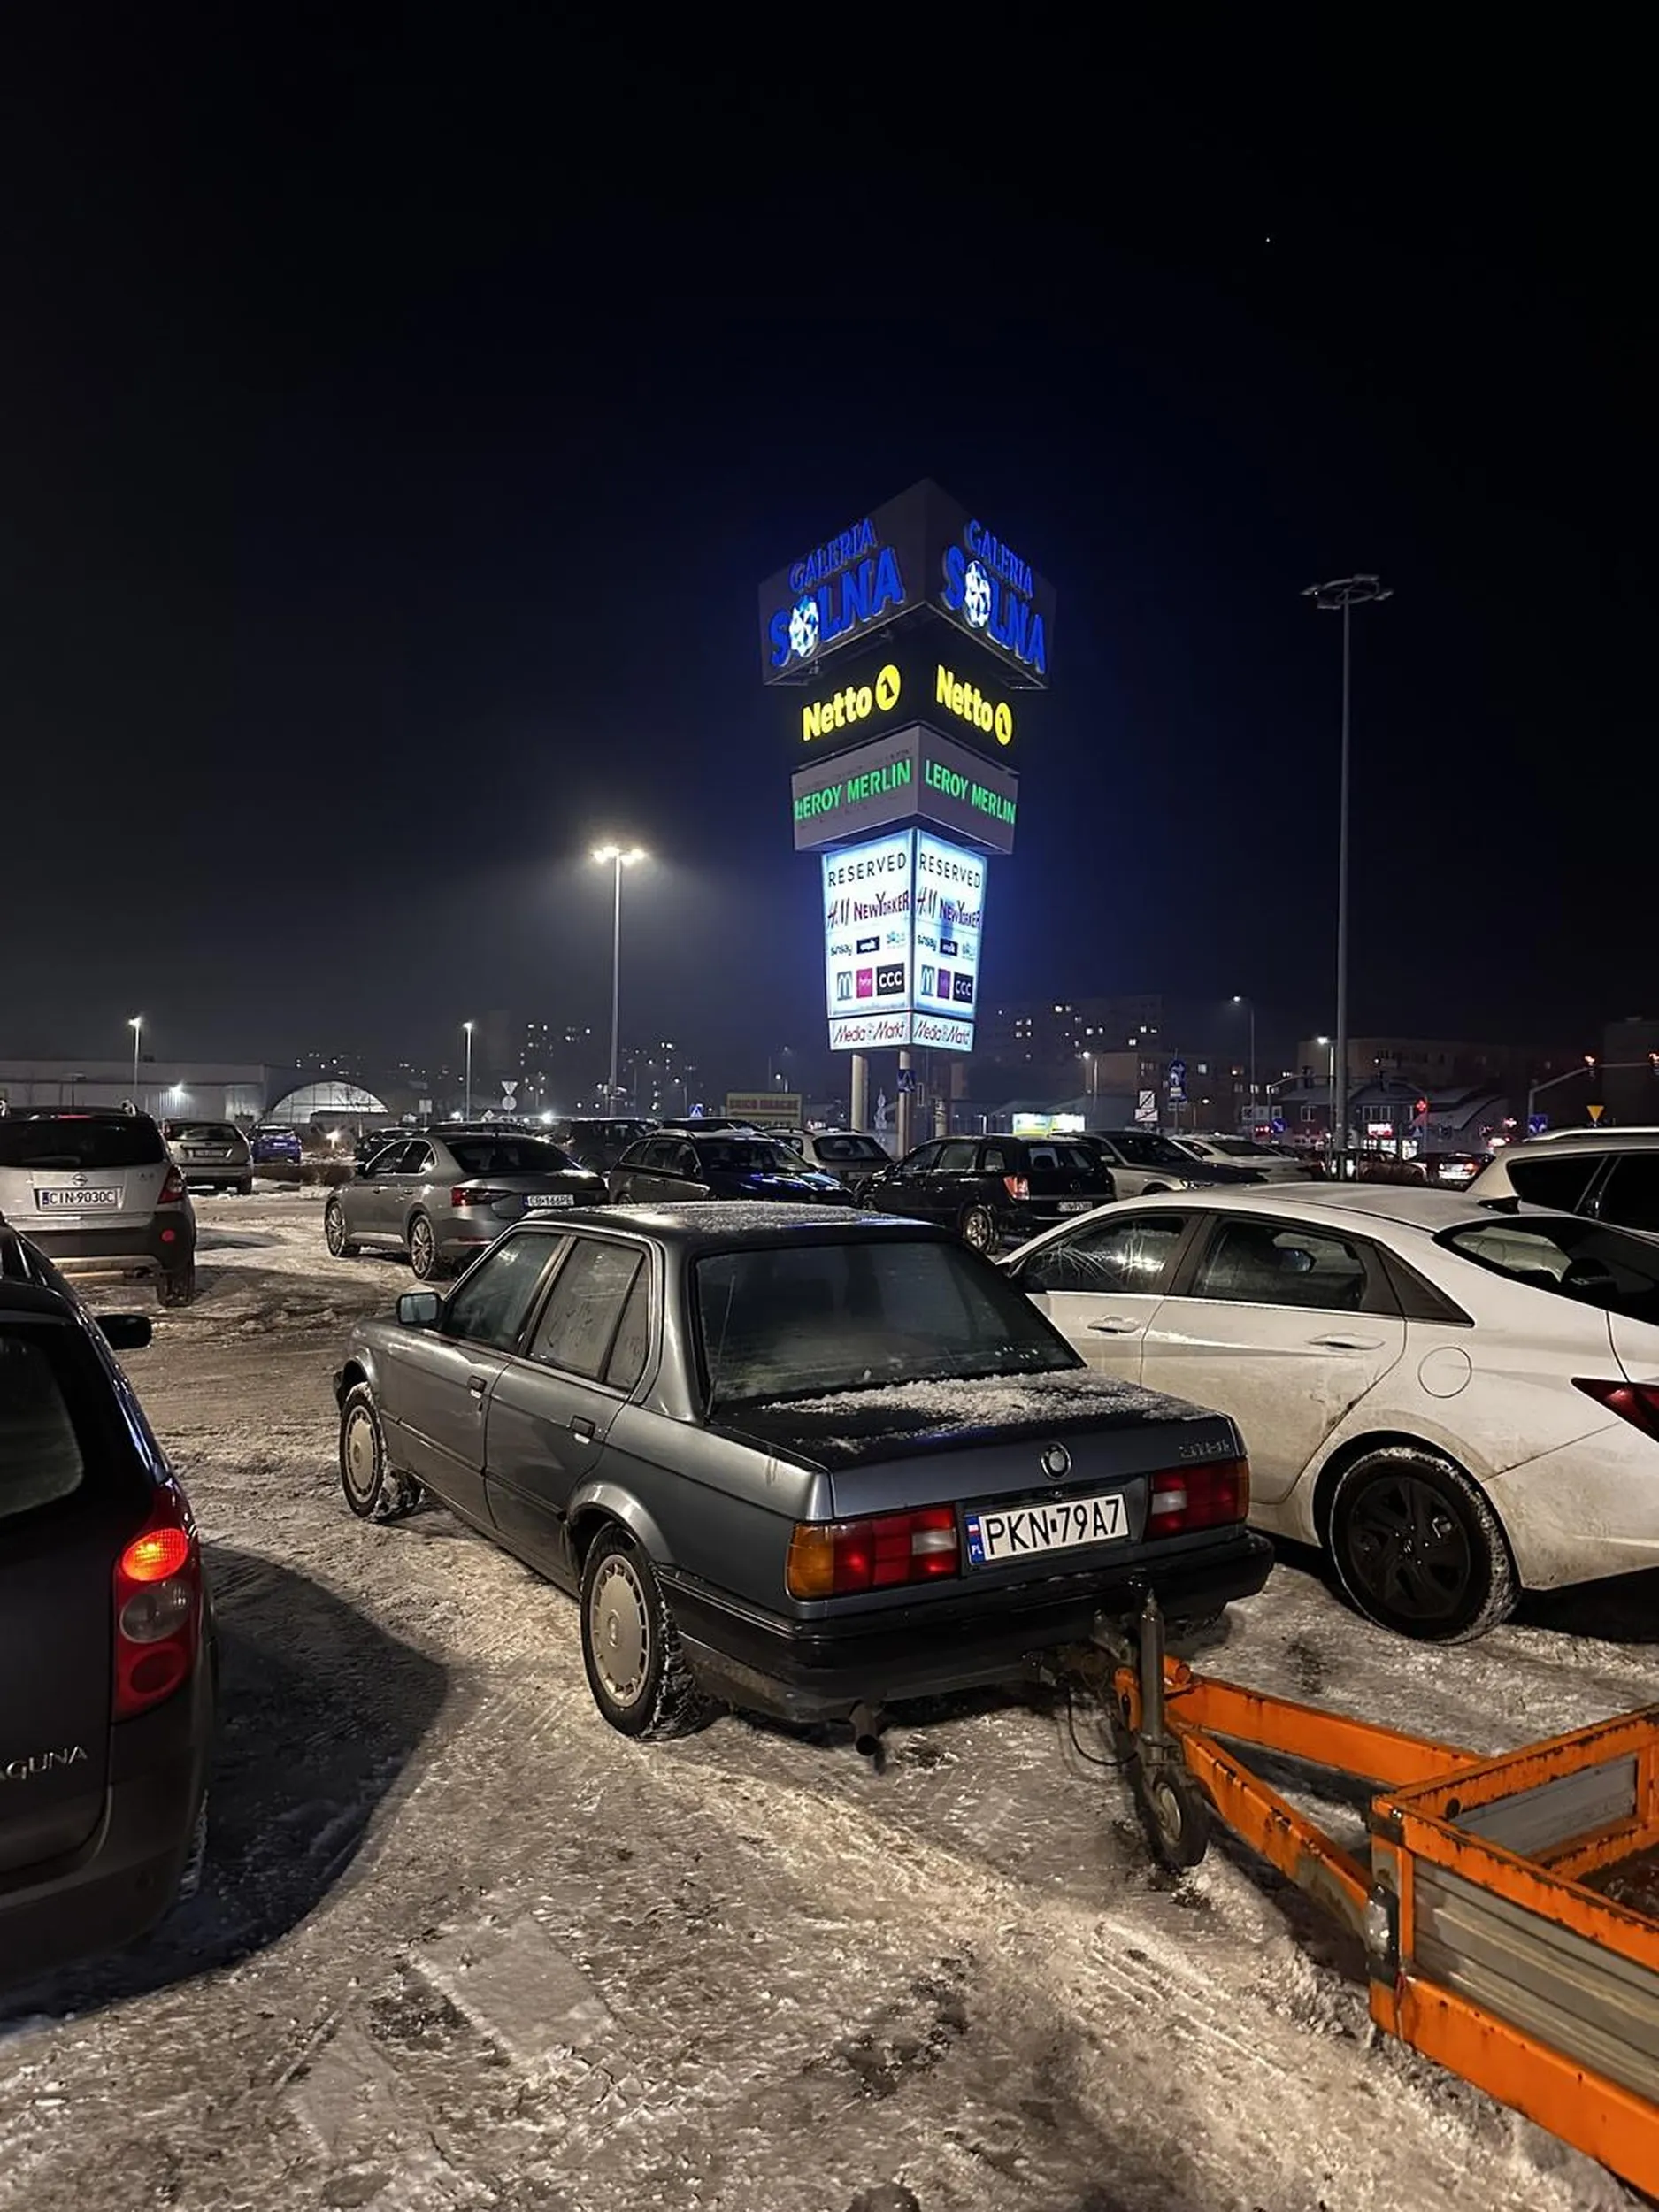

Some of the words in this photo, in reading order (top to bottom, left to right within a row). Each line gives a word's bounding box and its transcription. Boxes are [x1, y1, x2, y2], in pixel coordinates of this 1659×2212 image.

[789, 517, 878, 593] GALERIA
[964, 519, 1033, 599] GALERIA
[803, 684, 873, 741] Netto
[936, 664, 994, 733] Netto
[794, 783, 843, 820] LEROY
[847, 758, 911, 803] MERLIN
[925, 759, 970, 801] LEROY
[971, 783, 1017, 825] MERLIN
[828, 852, 907, 887] RESERVED
[919, 853, 981, 889] RESERVED
[878, 971, 902, 988] CCC
[955, 979, 972, 996] CCC
[833, 1024, 866, 1044] Media
[913, 1020, 942, 1041] Media
[985, 1509, 1052, 1555] PKN
[1056, 1498, 1120, 1543] 79A7
